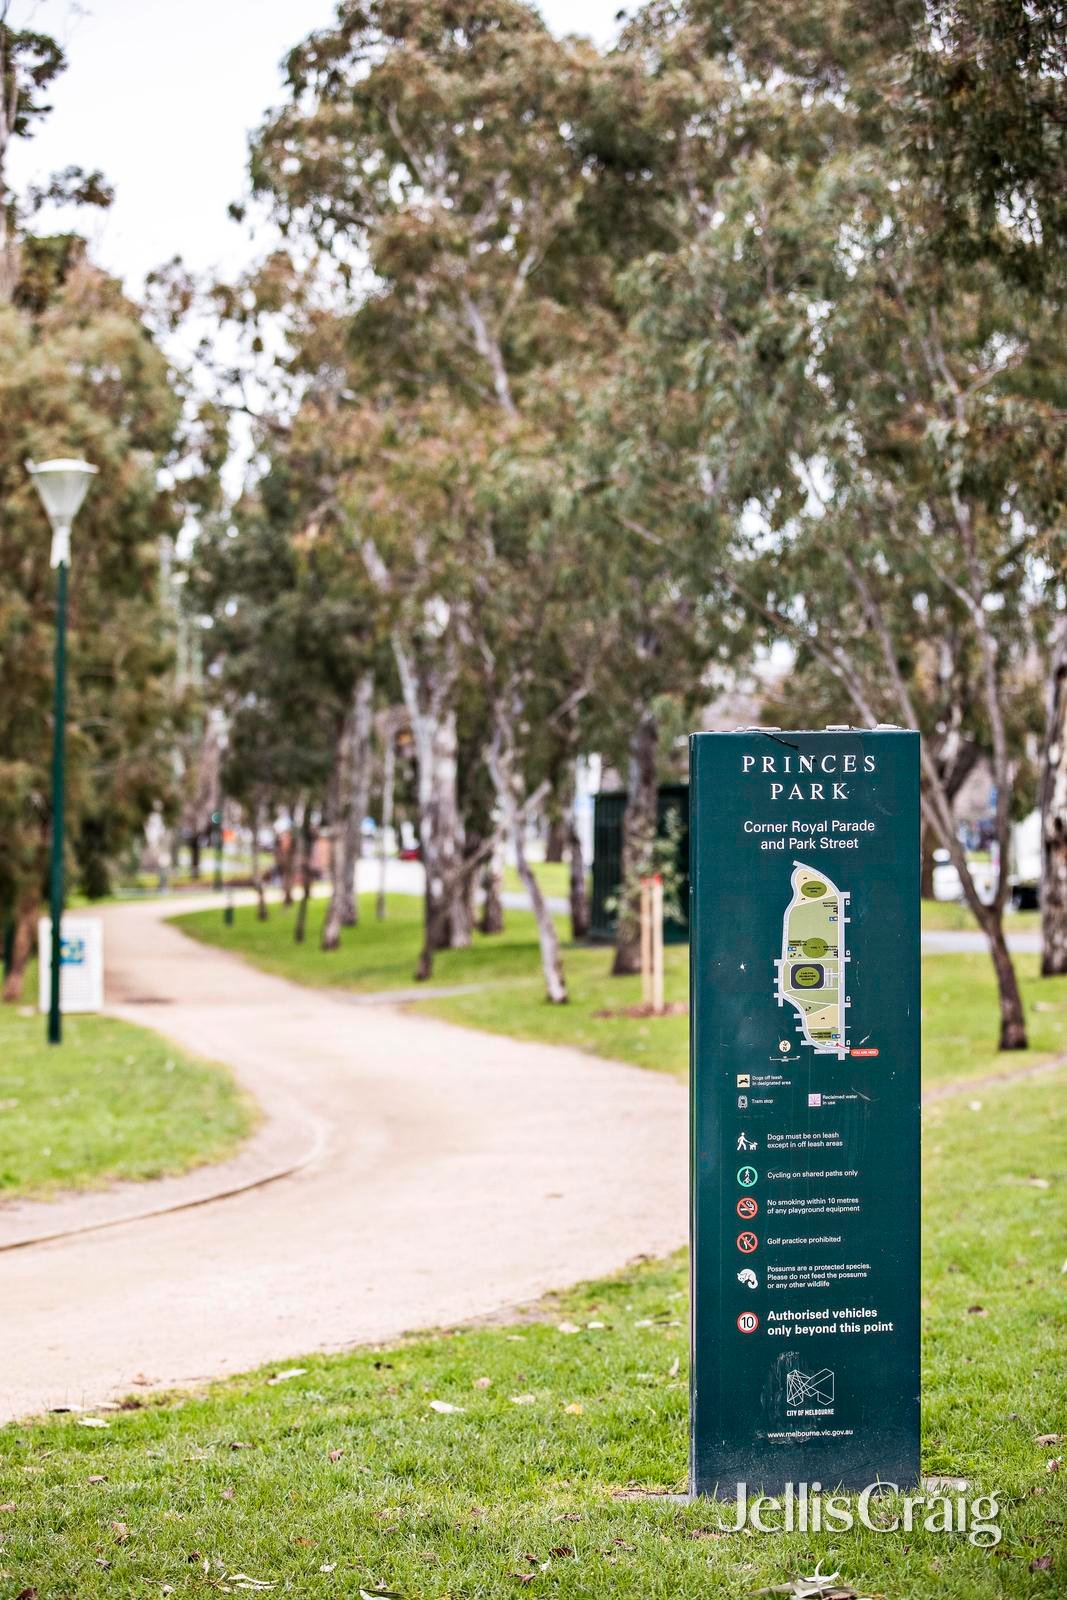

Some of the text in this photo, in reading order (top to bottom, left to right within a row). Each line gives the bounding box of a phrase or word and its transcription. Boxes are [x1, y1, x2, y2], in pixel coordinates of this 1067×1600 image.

[742, 755, 876, 773] PRINCES
[771, 783, 848, 800] PARK
[744, 820, 875, 835] Corner Royal Parade
[761, 838, 859, 850] and Park Street
[809, 1236, 841, 1244] prohibited
[767, 1308, 877, 1320] Authorised vehicles
[742, 1317, 754, 1328] 10
[768, 1322, 893, 1337] only beyond this point
[768, 1429, 853, 1438] www.melbourne.vic.gov.au
